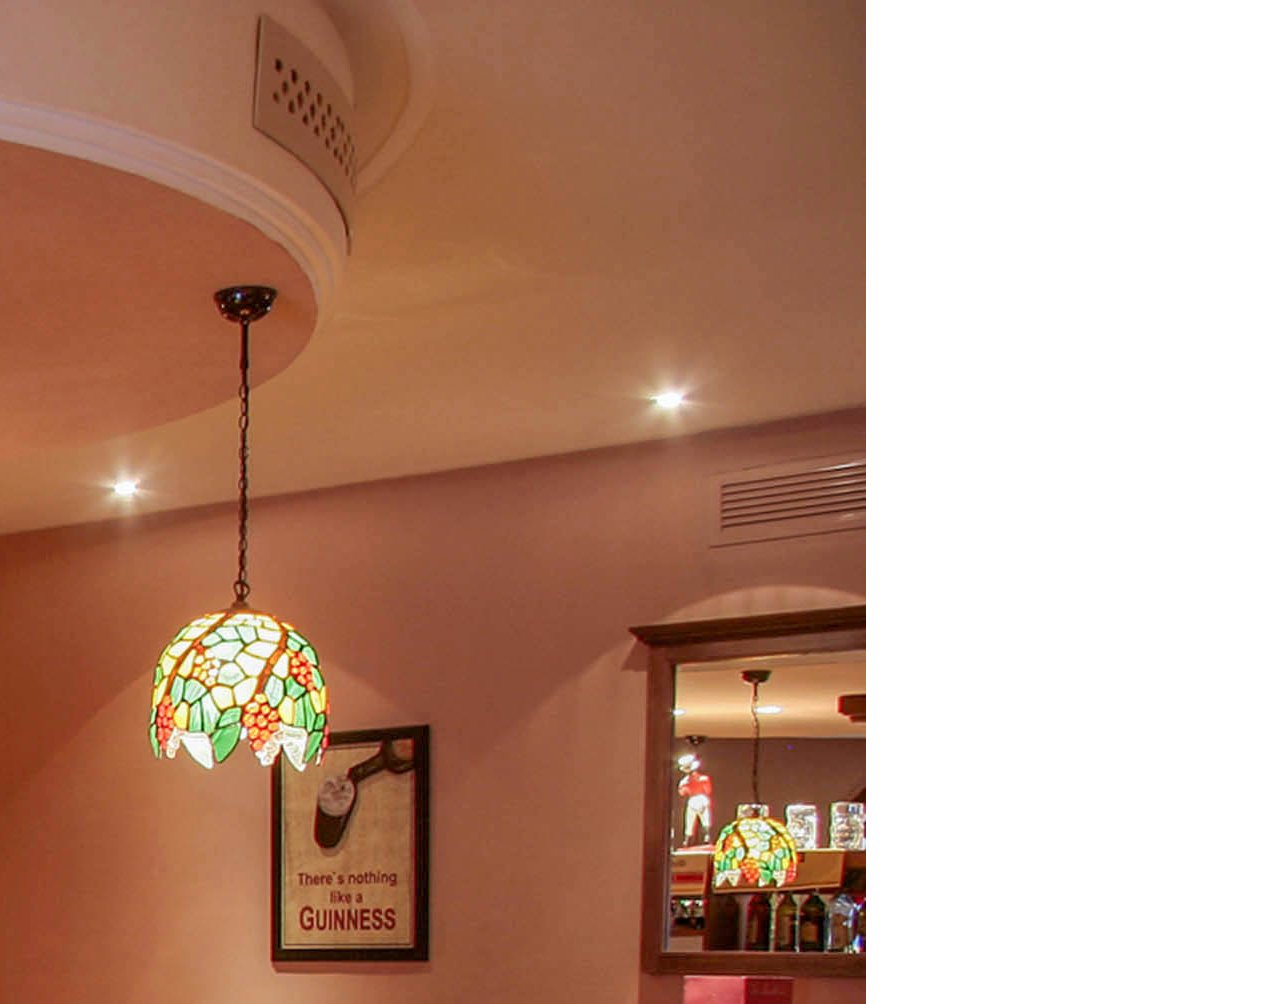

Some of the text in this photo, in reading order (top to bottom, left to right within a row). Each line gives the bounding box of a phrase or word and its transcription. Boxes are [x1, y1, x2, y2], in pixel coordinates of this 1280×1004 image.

[347, 871, 397, 887] nothing
[330, 891, 363, 904] like a
[299, 905, 397, 931] GUINNESS
